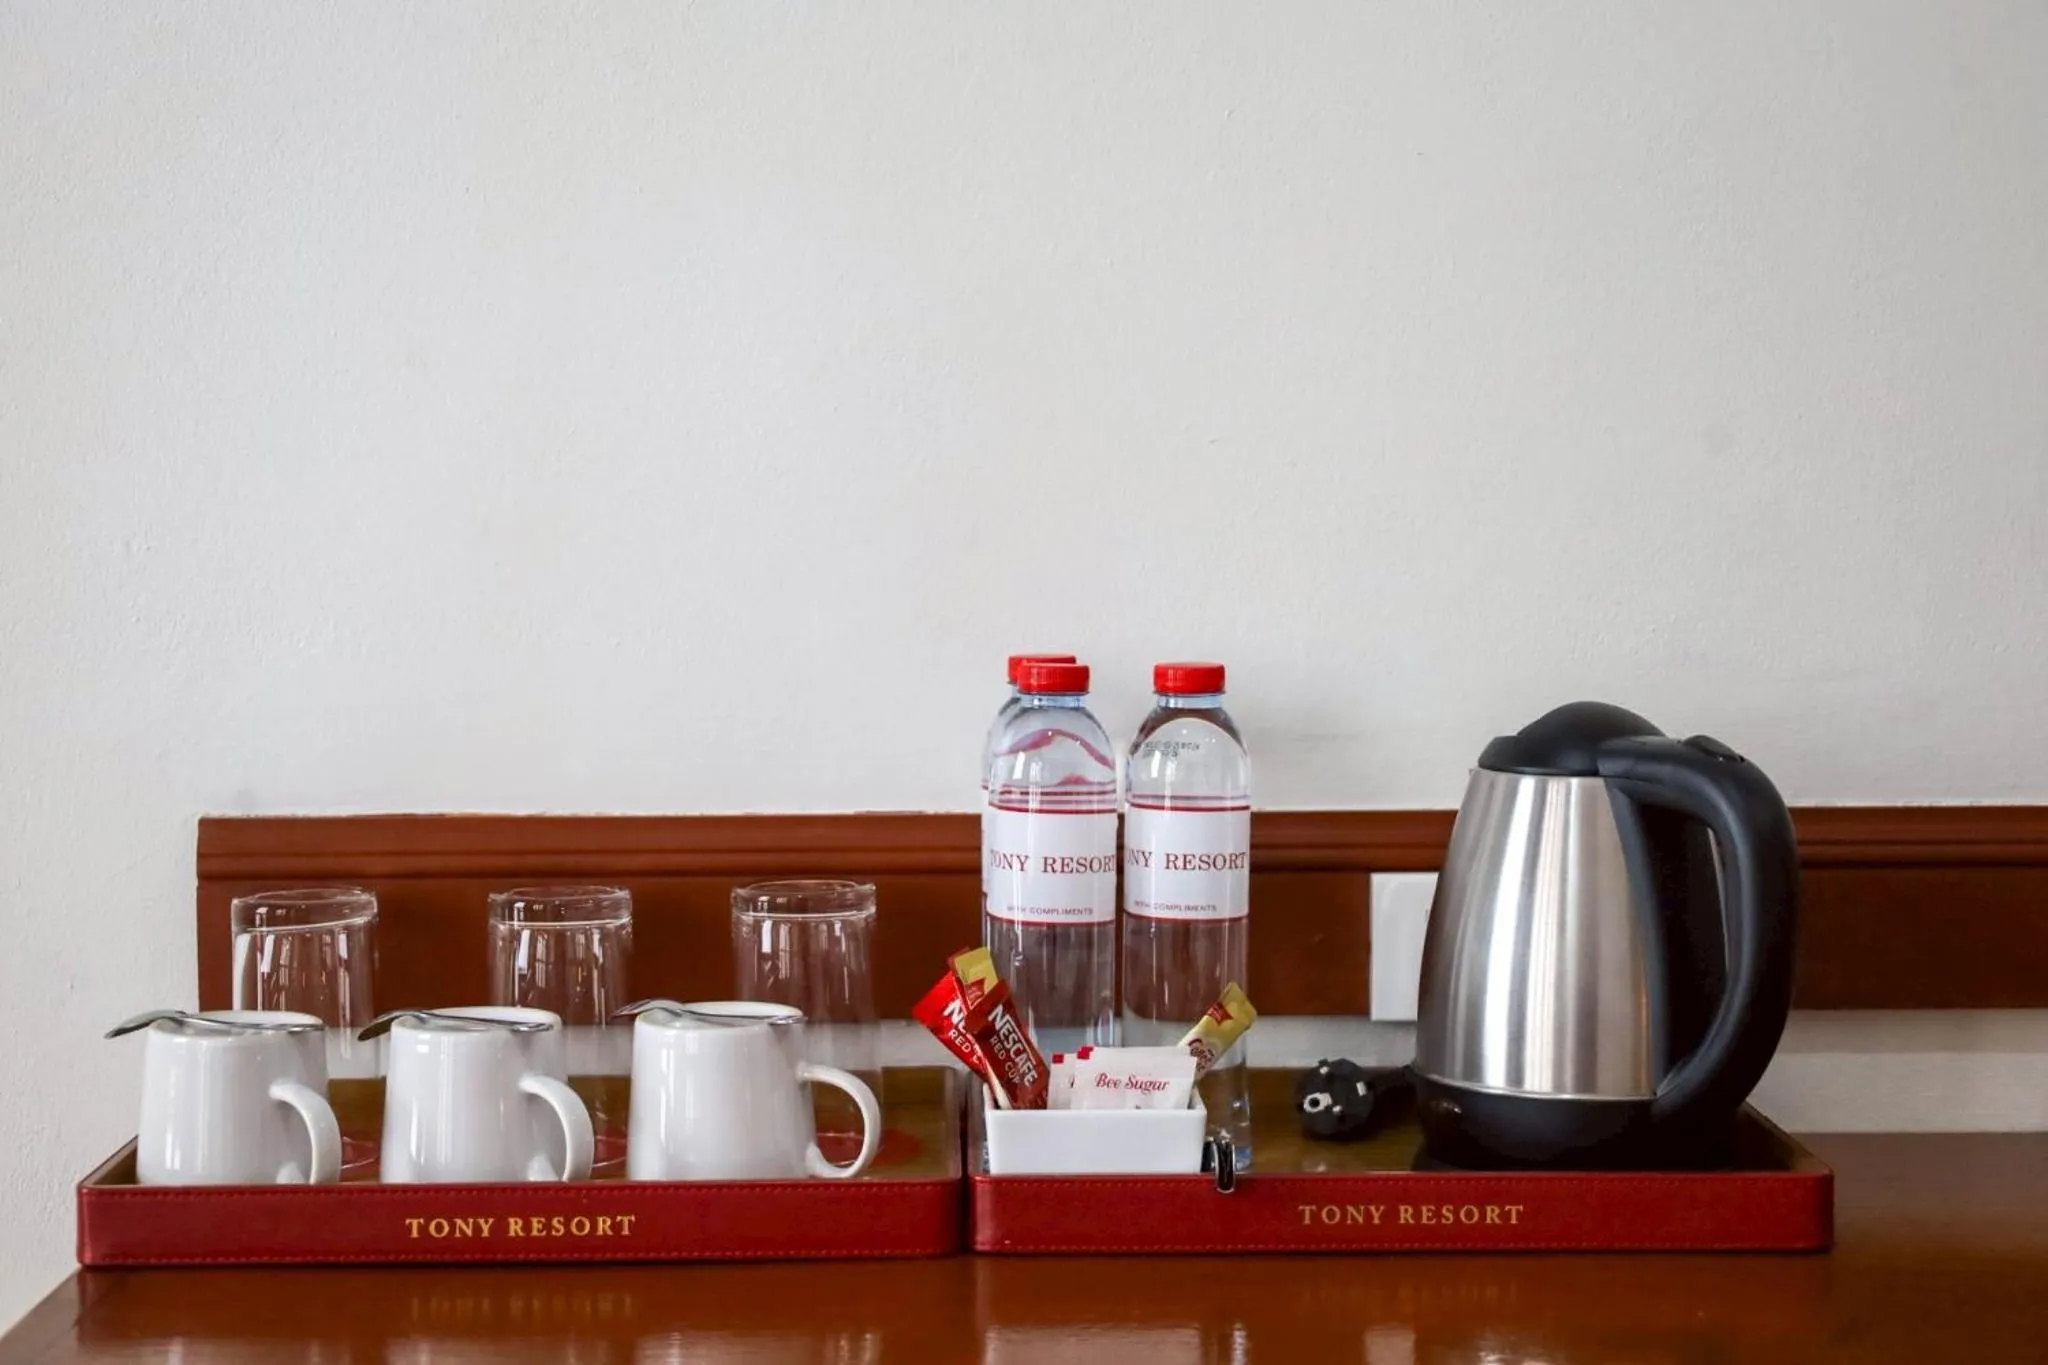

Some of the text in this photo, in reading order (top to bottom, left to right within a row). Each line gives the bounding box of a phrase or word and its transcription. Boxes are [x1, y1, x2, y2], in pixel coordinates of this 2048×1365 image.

[1165, 851, 1247, 871] RESORT
[948, 1029, 972, 1053] RED
[989, 1035, 1007, 1060] RED
[1095, 1072, 1121, 1089] Bee
[1125, 1073, 1170, 1096] Sugar
[405, 1214, 636, 1239] TONY RESORT
[1297, 1204, 1524, 1225] TONY RESORT
